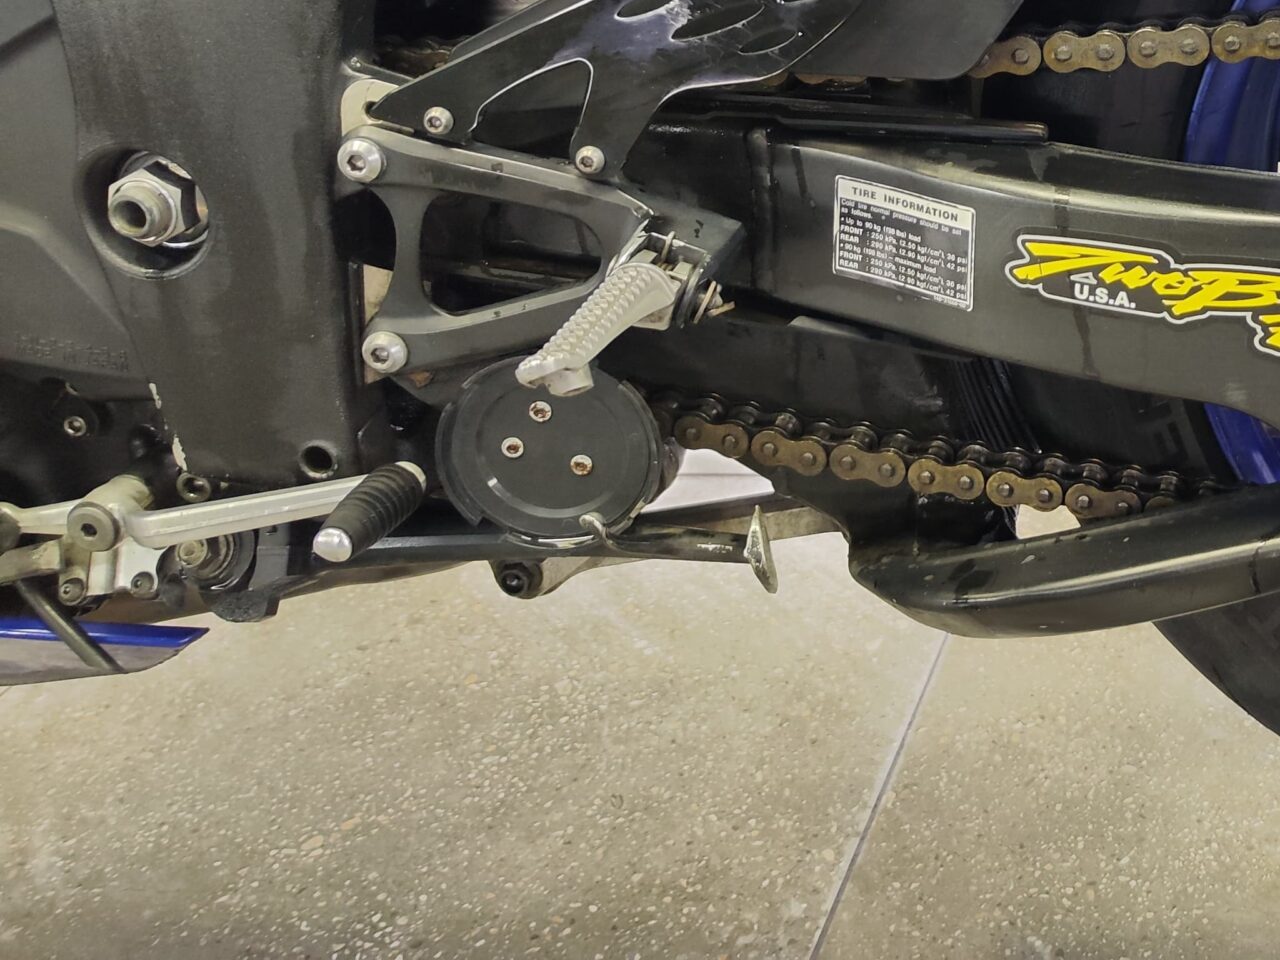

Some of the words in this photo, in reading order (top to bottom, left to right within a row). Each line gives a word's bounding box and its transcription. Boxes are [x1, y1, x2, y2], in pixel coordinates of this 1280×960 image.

[841, 199, 855, 208] Cold
[857, 202, 868, 210] tire
[870, 206, 890, 216] normal
[892, 212, 917, 224] pressure
[920, 219, 939, 230] should
[941, 225, 950, 233] be
[952, 228, 962, 237] set
[852, 187, 877, 200] TIRE
[884, 194, 958, 222] INFORMATION
[840, 224, 864, 236] FRONT
[870, 231, 884, 241] 250
[957, 256, 968, 265] psi
[845, 217, 855, 225] Up
[865, 221, 873, 230] 90
[873, 223, 881, 233] kg
[908, 233, 922, 243] load
[840, 233, 860, 244] REAR
[870, 240, 884, 250] 290
[946, 262, 956, 270] 42
[957, 265, 968, 273] psi
[840, 250, 863, 262] FRONT
[870, 257, 883, 267] 250
[956, 283, 967, 292] psi
[845, 242, 853, 251] 90
[853, 244, 861, 254] kg
[894, 256, 922, 270] maximum
[923, 263, 937, 274] load
[1013, 242, 1193, 297] Two
[839, 258, 859, 270] REAR
[945, 288, 955, 297] 42
[956, 292, 967, 300] psi
[1073, 284, 1137, 308] U.S.A.
